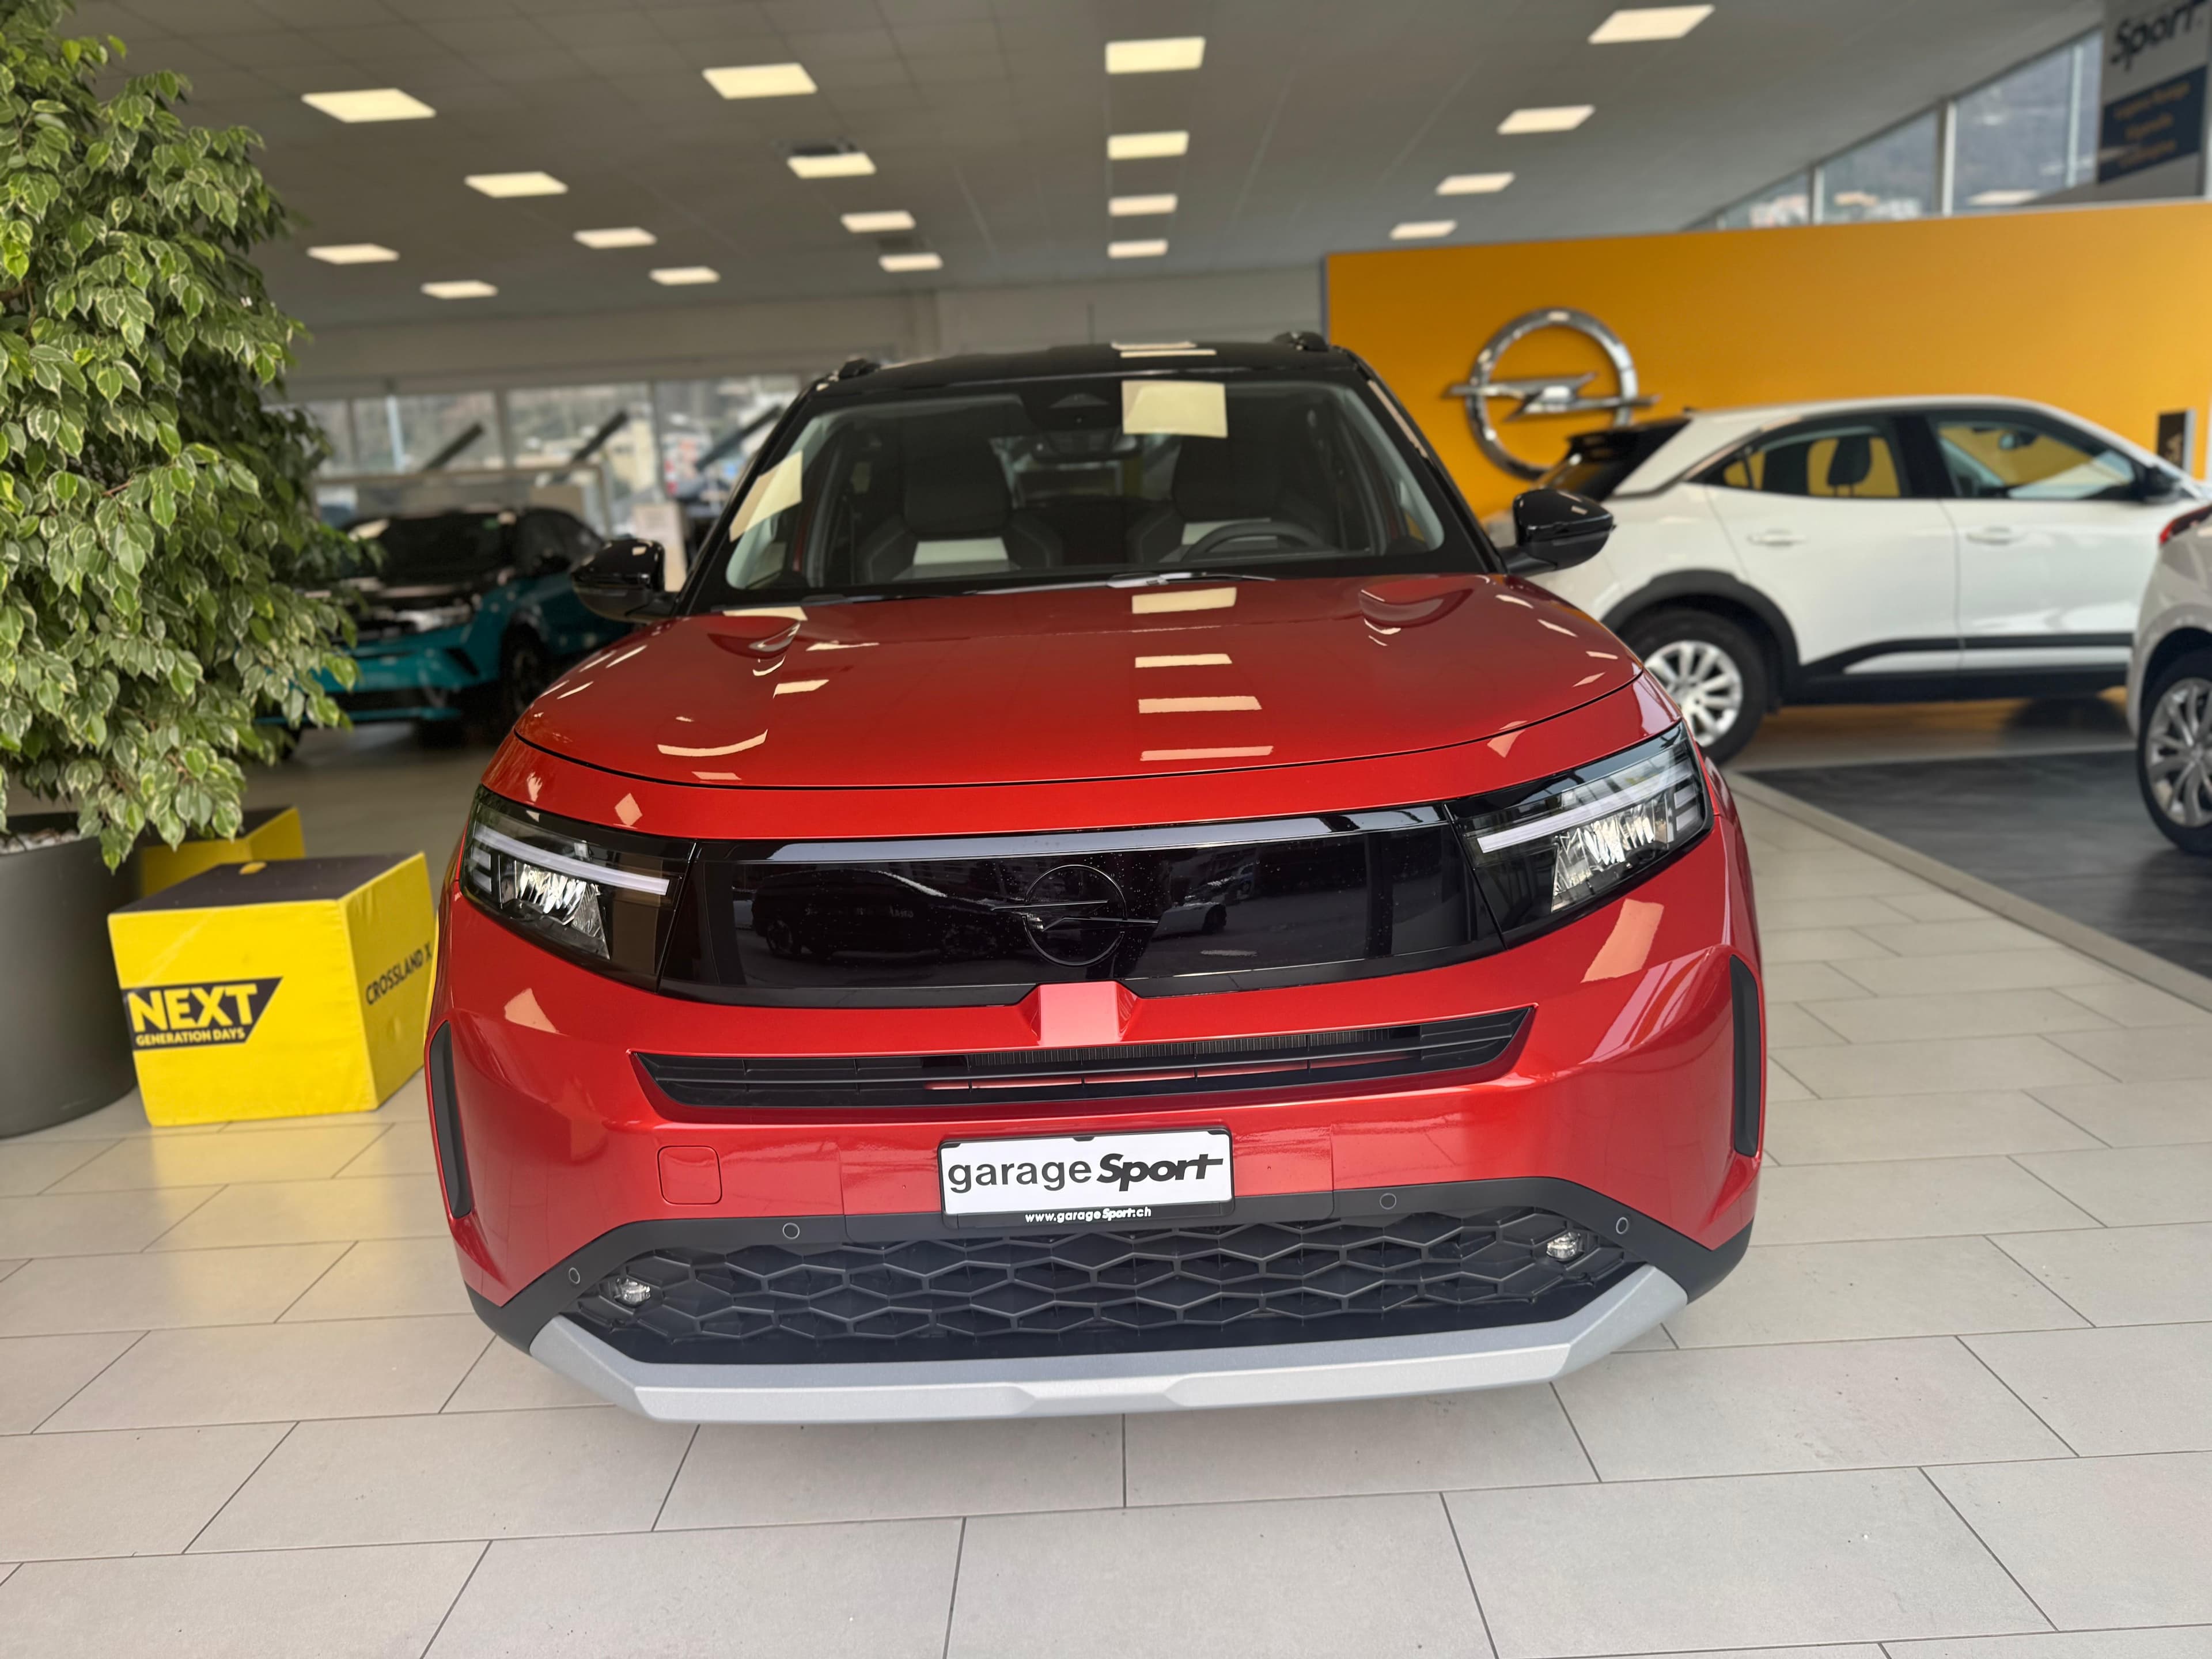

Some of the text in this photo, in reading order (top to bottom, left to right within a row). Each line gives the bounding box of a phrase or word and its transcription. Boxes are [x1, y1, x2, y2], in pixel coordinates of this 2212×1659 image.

[365, 941, 432, 1005] CROSSLAND X
[127, 983, 257, 1032] NEXT
[136, 1027, 245, 1046] GENERATION DAYS
[948, 1153, 1223, 1194] garage Sport
